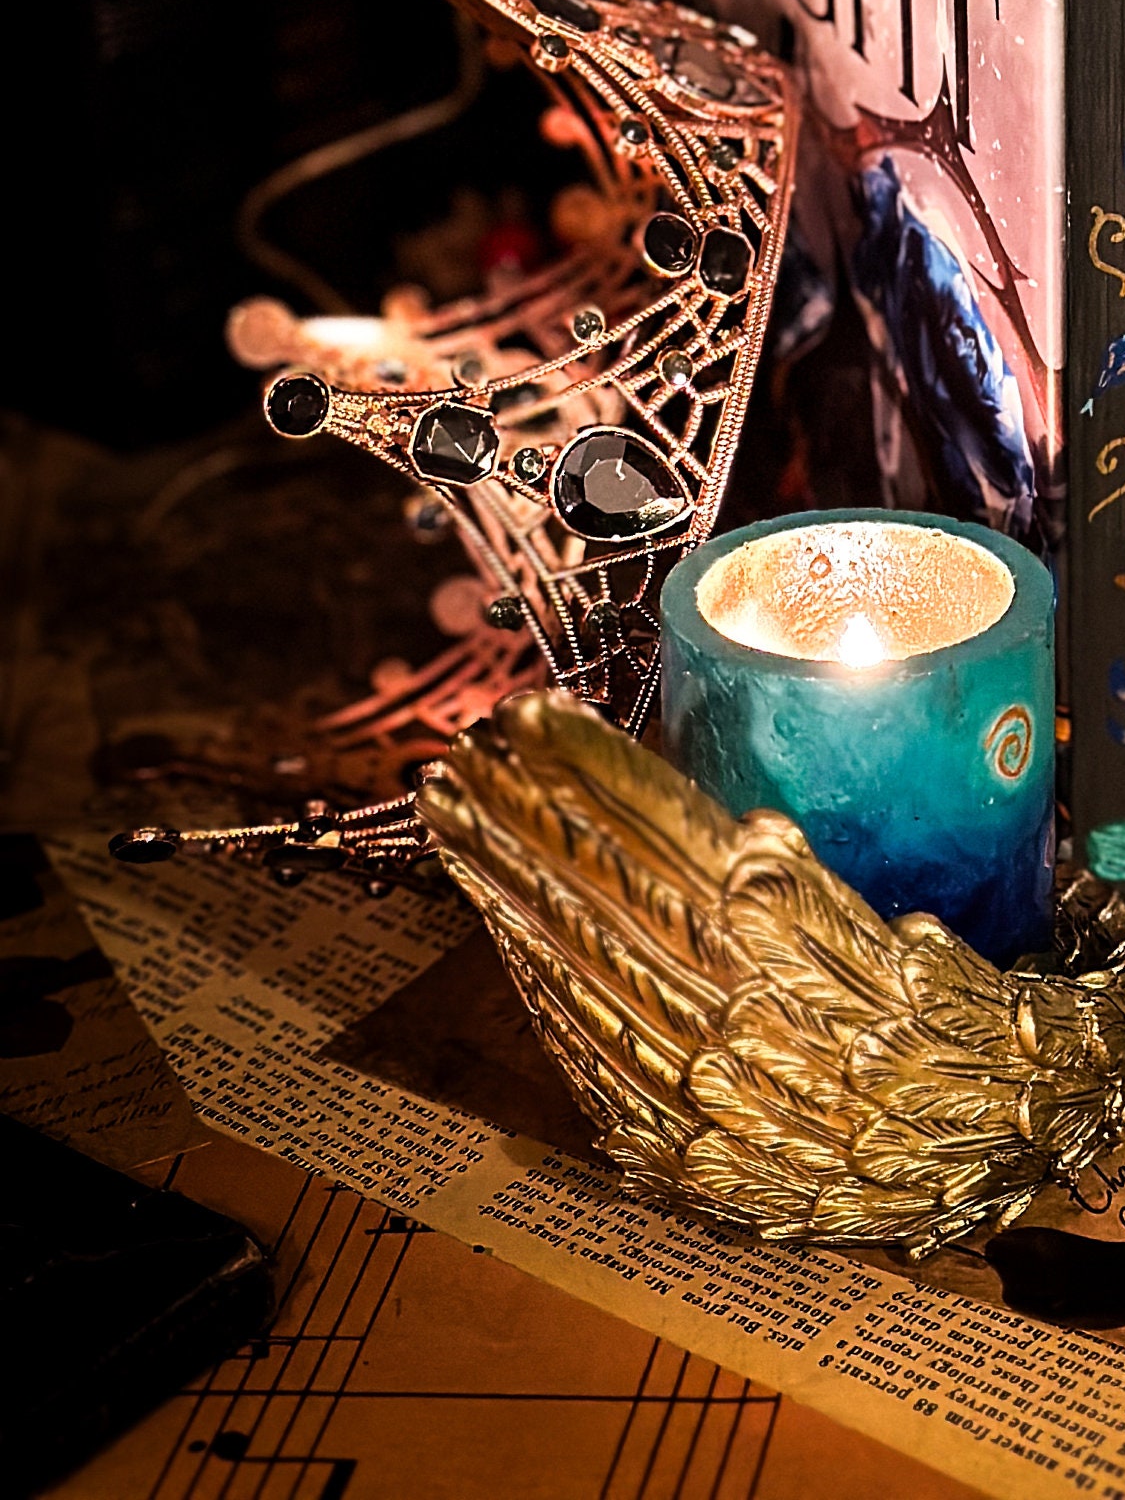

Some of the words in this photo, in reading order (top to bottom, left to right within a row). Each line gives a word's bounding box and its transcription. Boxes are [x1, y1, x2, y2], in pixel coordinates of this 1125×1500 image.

[566, 1184, 595, 1203] the
[556, 1202, 586, 1219] has
[545, 1215, 572, 1230] the
[587, 1214, 610, 1230] he
[573, 1227, 607, 1244] and
[608, 1224, 645, 1244] that
[740, 1262, 783, 1283] some
[644, 1274, 675, 1295] Mr.
[703, 1282, 723, 1295] in
[782, 1280, 812, 1296] for
[838, 1286, 866, 1302] for
[682, 1292, 731, 1316] given
[811, 1291, 828, 1303] it
[829, 1298, 852, 1311] on
[892, 1292, 935, 1312] 1979
[723, 1291, 790, 1325] interest
[783, 1297, 836, 1326] House
[938, 1308, 959, 1322] in
[727, 1313, 762, 1334] But
[865, 1313, 885, 1327] in
[948, 1330, 992, 1354] them
[960, 1318, 1034, 1350] percent
[1022, 1325, 1052, 1342] the
[836, 1340, 848, 1349] a
[887, 1324, 985, 1368] questioned
[1030, 1347, 1055, 1362] 21
[846, 1346, 902, 1376] found
[991, 1350, 1036, 1371] read
[1056, 1356, 1095, 1378] with
[903, 1370, 940, 1391] also
[926, 1358, 1011, 1400] astrology
[991, 1365, 1040, 1394] those
[913, 1398, 938, 1416] 88
[945, 1388, 1006, 1422] survey
[1012, 1396, 1034, 1414] in
[1040, 1390, 1066, 1404] of
[945, 1411, 991, 1441] from
[1008, 1417, 1044, 1444] The
[1032, 1407, 1106, 1448] interest
